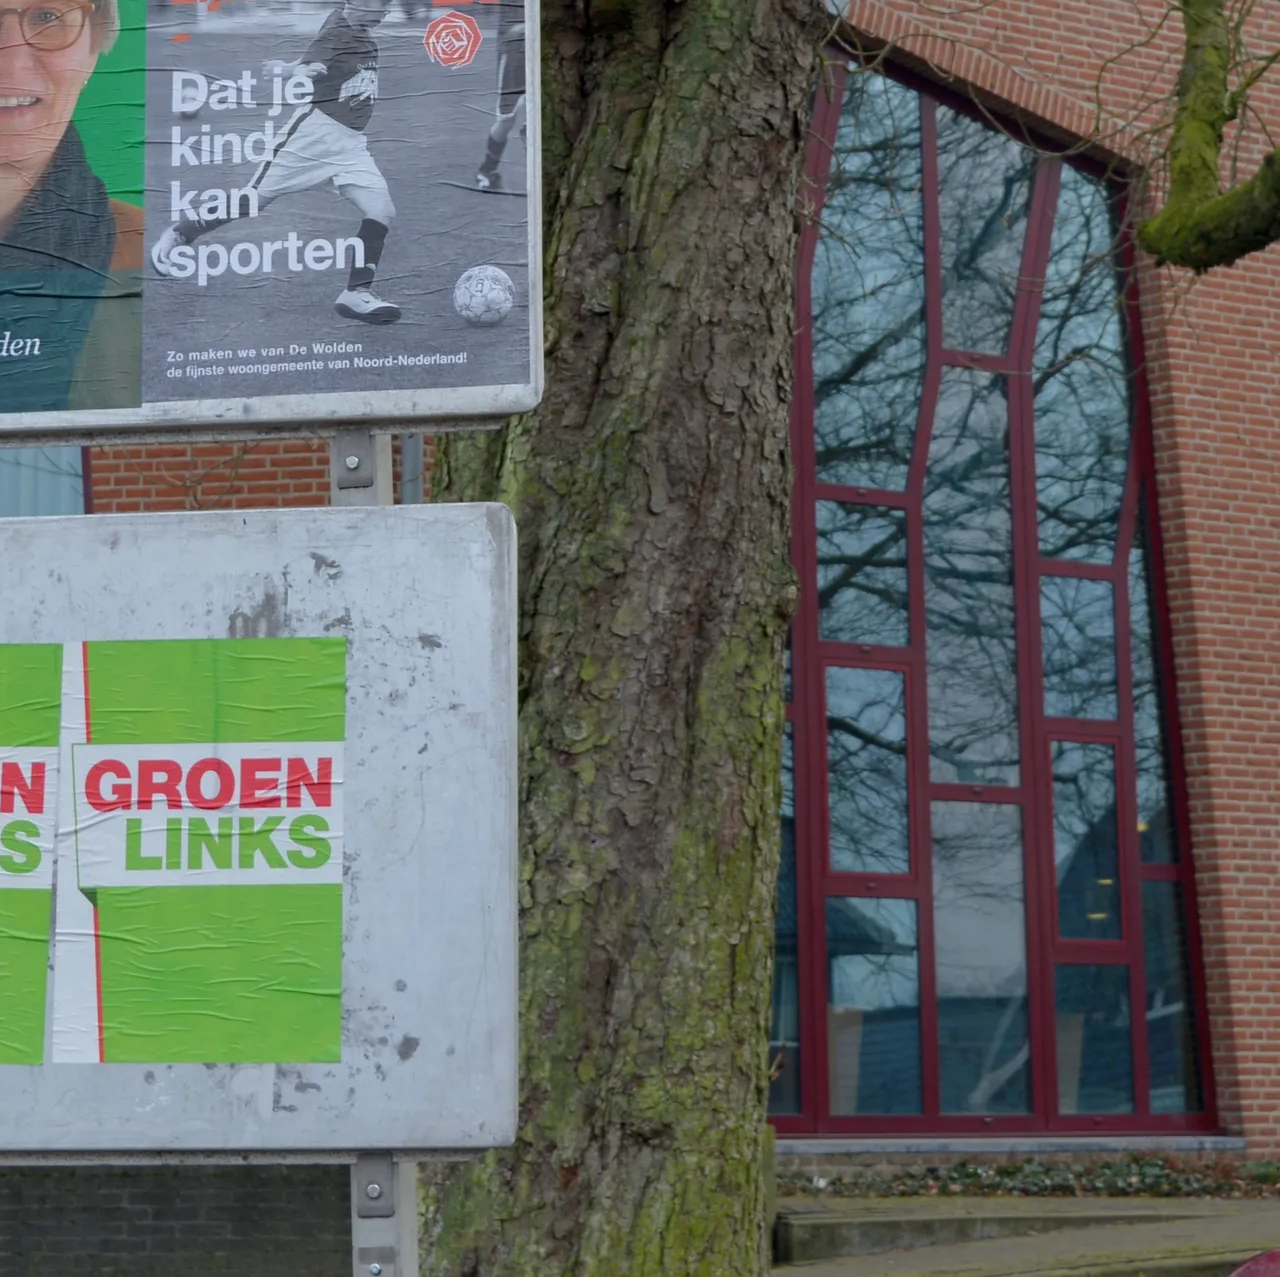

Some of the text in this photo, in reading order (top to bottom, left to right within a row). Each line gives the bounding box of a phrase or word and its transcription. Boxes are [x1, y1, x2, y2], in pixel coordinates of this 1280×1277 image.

[171, 66, 314, 117] Dat je
[171, 120, 275, 166] kind
[171, 180, 260, 222] kan
[169, 231, 365, 286] sporten
[167, 342, 363, 362] Zo maken we van De Wolden
[167, 352, 468, 378] de fijnste woongemeente van Noord-Nederland!
[85, 757, 332, 811] GROEN
[125, 815, 332, 871] LINKS
